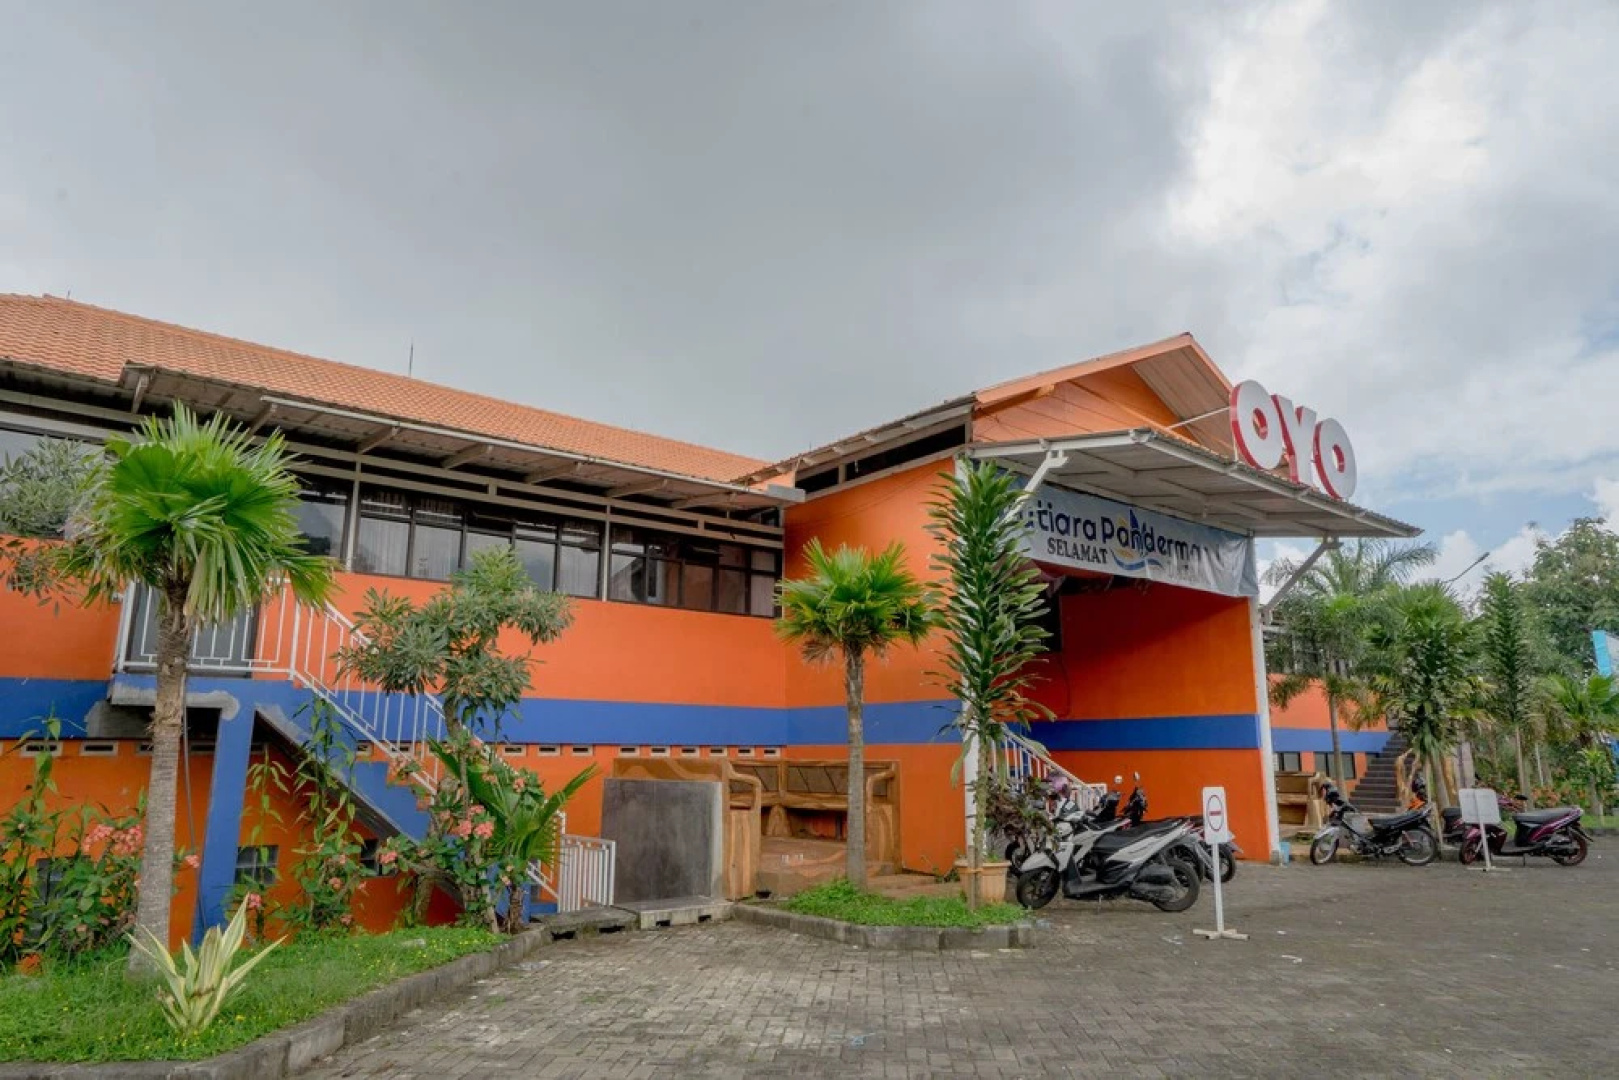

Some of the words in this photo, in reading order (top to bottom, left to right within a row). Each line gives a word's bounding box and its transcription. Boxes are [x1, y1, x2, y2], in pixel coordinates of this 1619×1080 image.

[1229, 379, 1357, 501] OYO
[1010, 500, 1097, 541] tiara
[1047, 538, 1107, 564] SELAMAT
